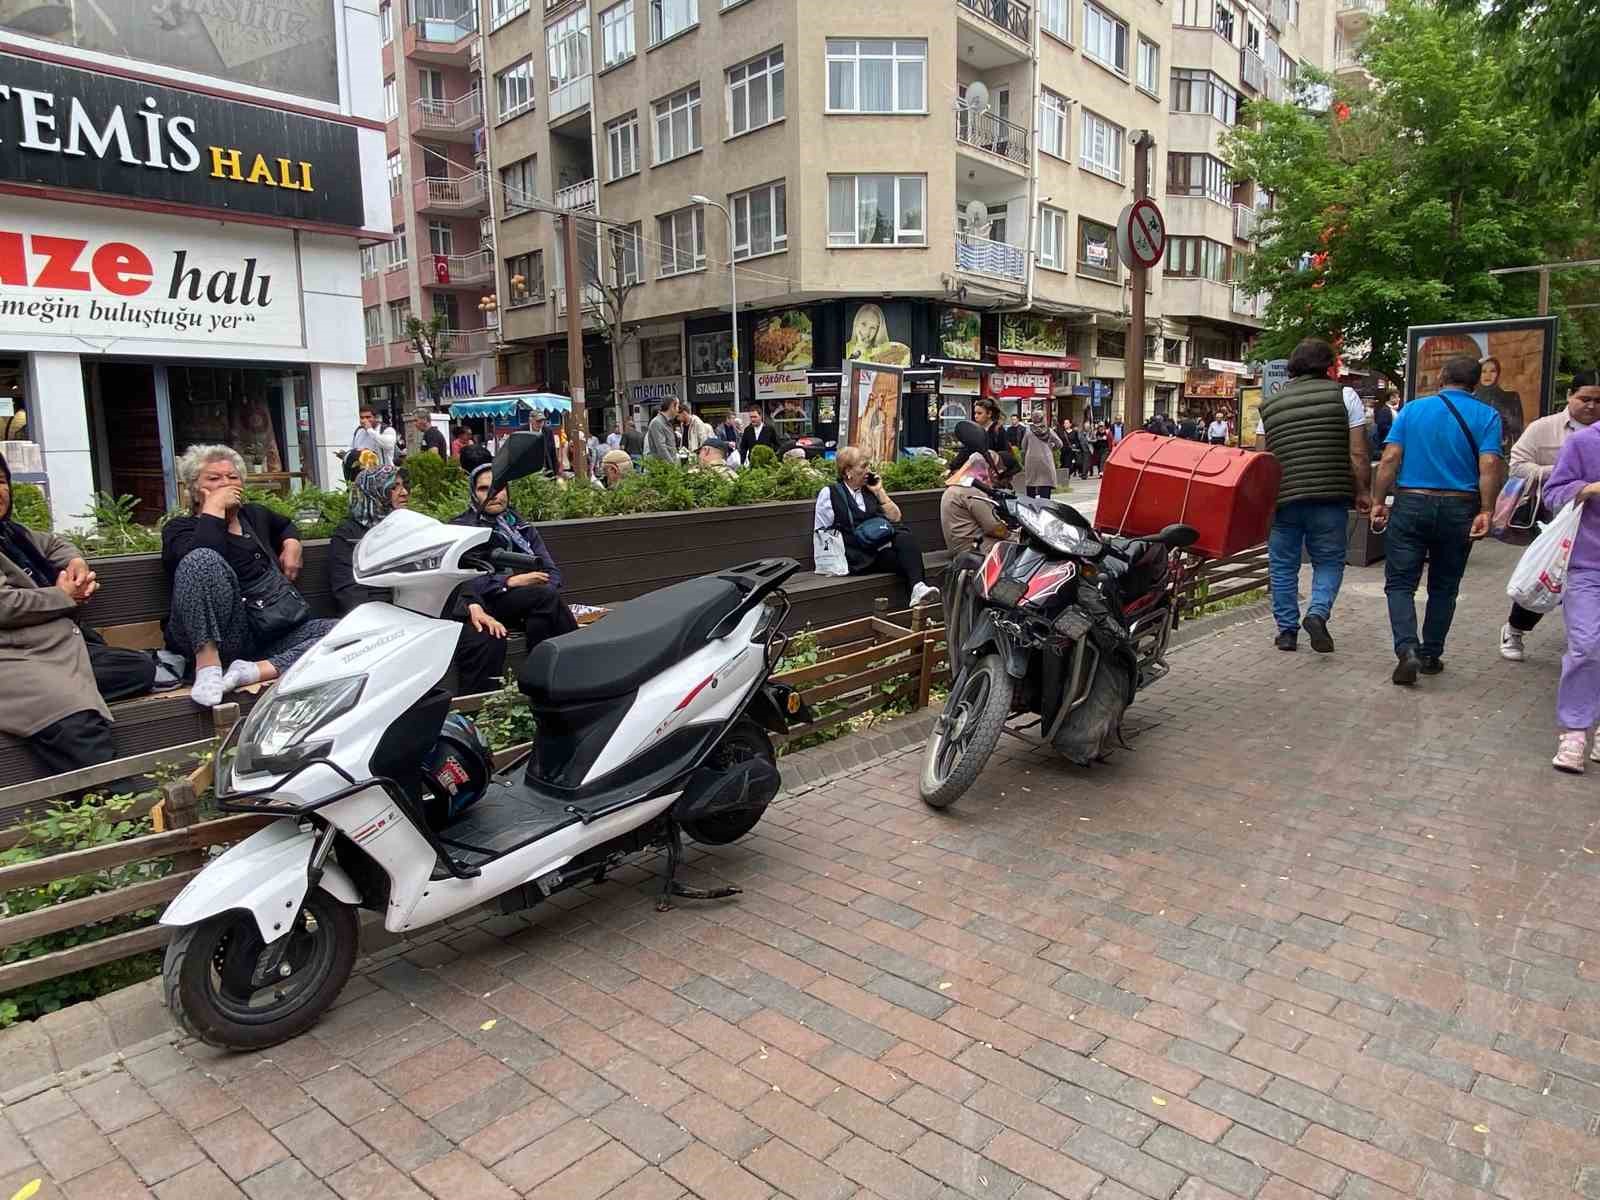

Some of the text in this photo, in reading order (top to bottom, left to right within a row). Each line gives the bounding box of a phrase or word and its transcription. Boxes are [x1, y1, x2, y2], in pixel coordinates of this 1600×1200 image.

[209, 145, 314, 192] HALI
[168, 250, 273, 307] halı
[0, 293, 80, 323] meğin
[89, 299, 201, 331] buluştuğu
[724, 381, 735, 393] HAL
